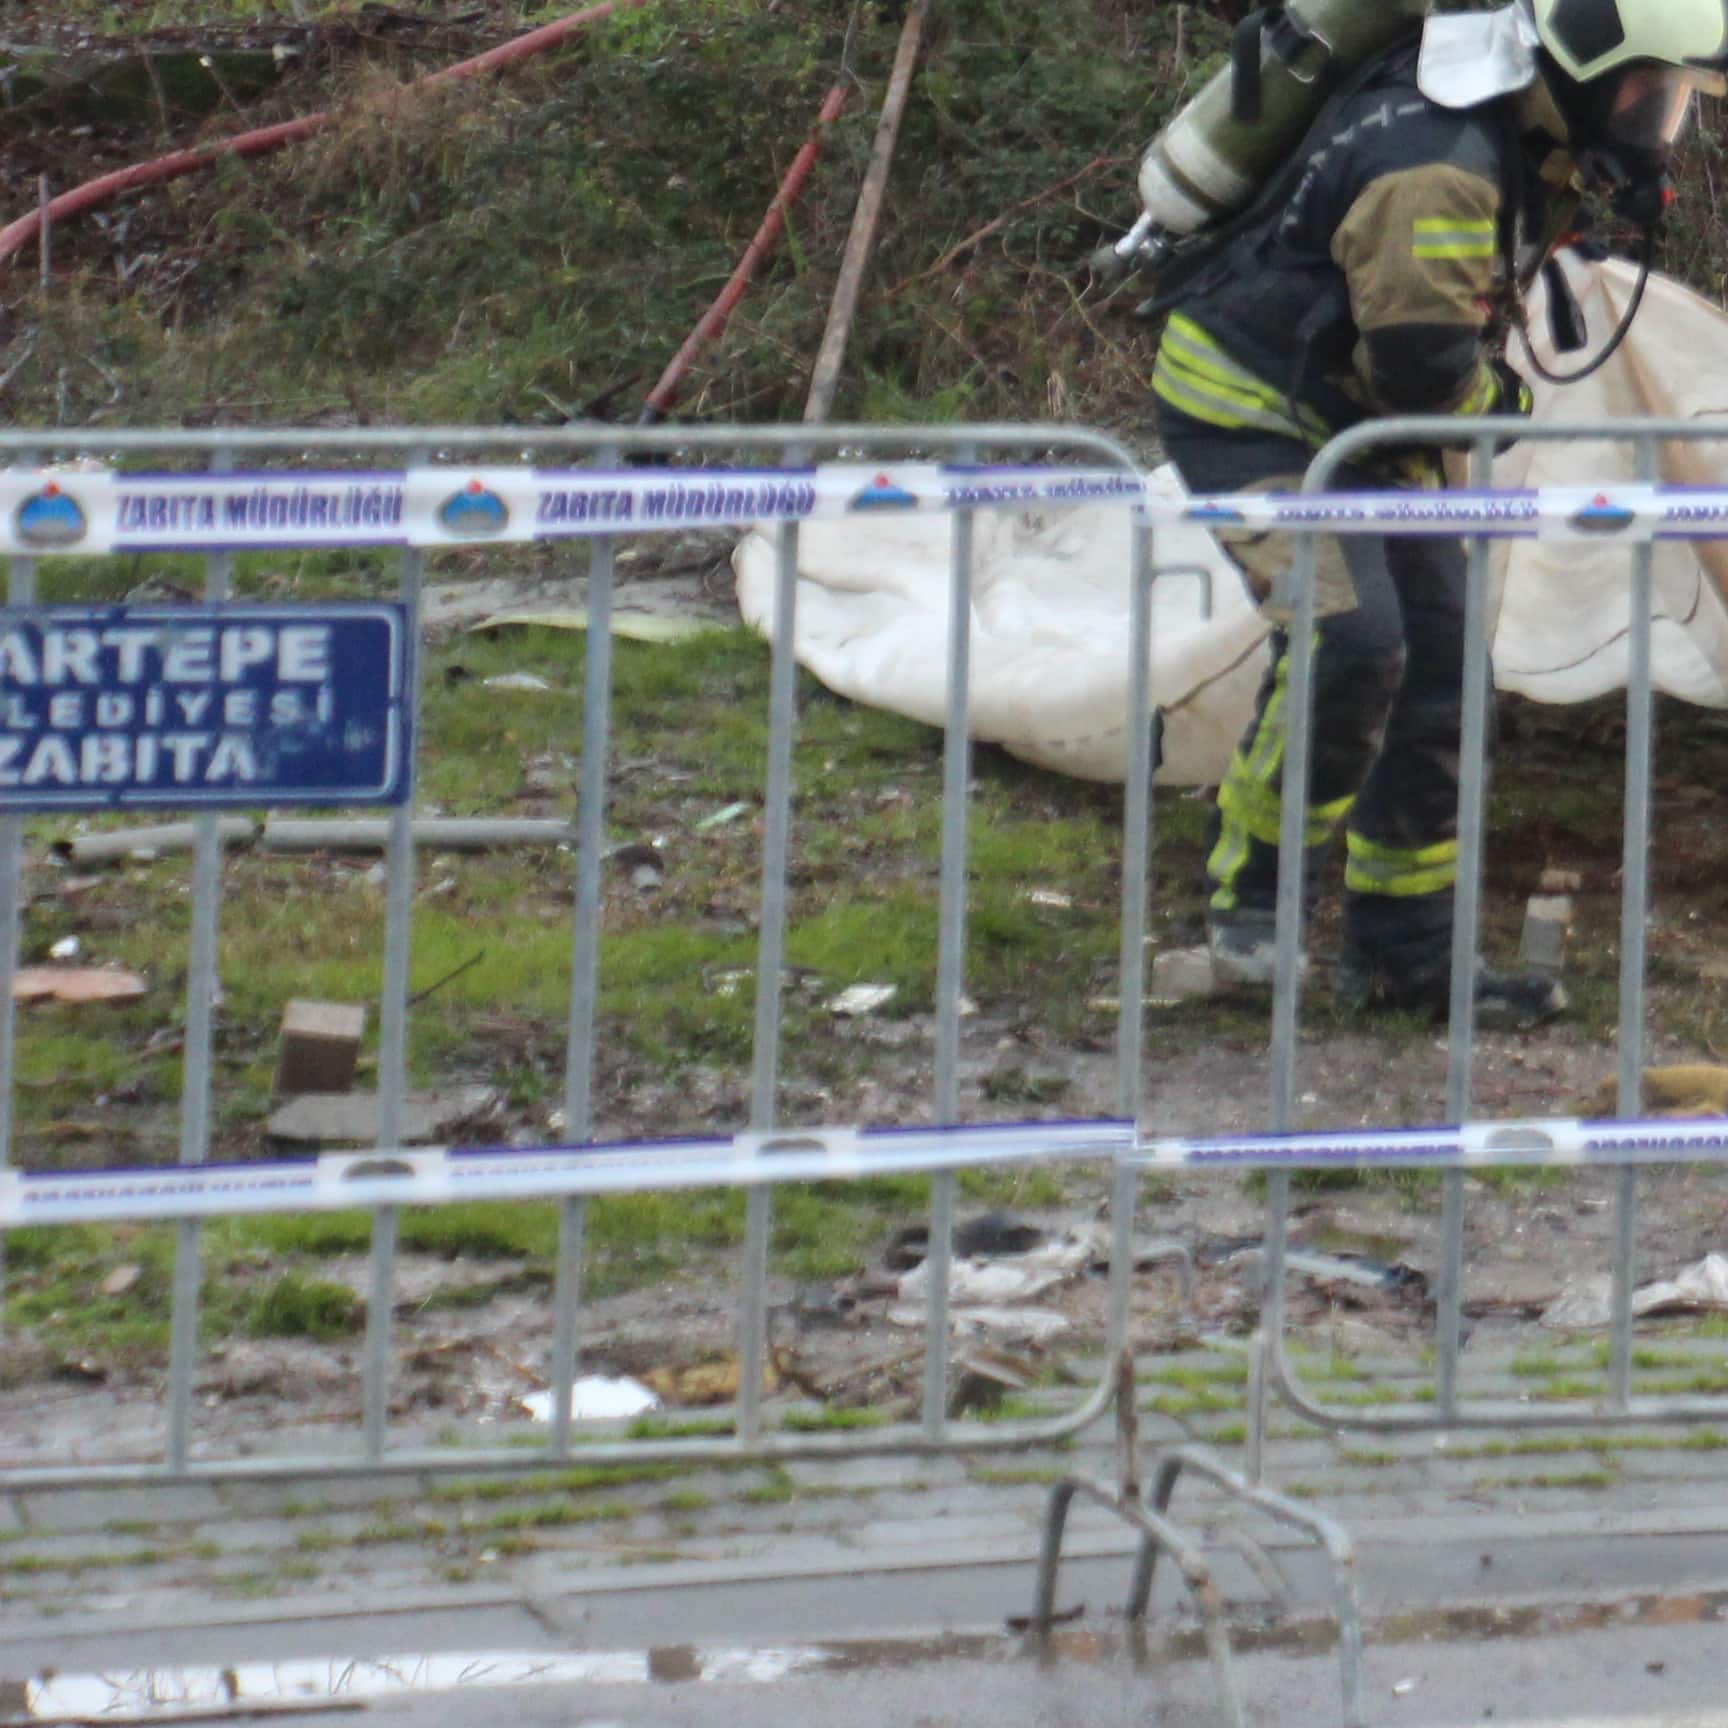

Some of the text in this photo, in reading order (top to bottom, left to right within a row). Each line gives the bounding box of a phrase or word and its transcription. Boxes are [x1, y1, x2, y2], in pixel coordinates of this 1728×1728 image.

[117, 494, 215, 534] ZABITA
[535, 489, 633, 523] ZABITA
[0, 625, 333, 686] ARTEPE
[4, 683, 333, 728] LEDİYESİ
